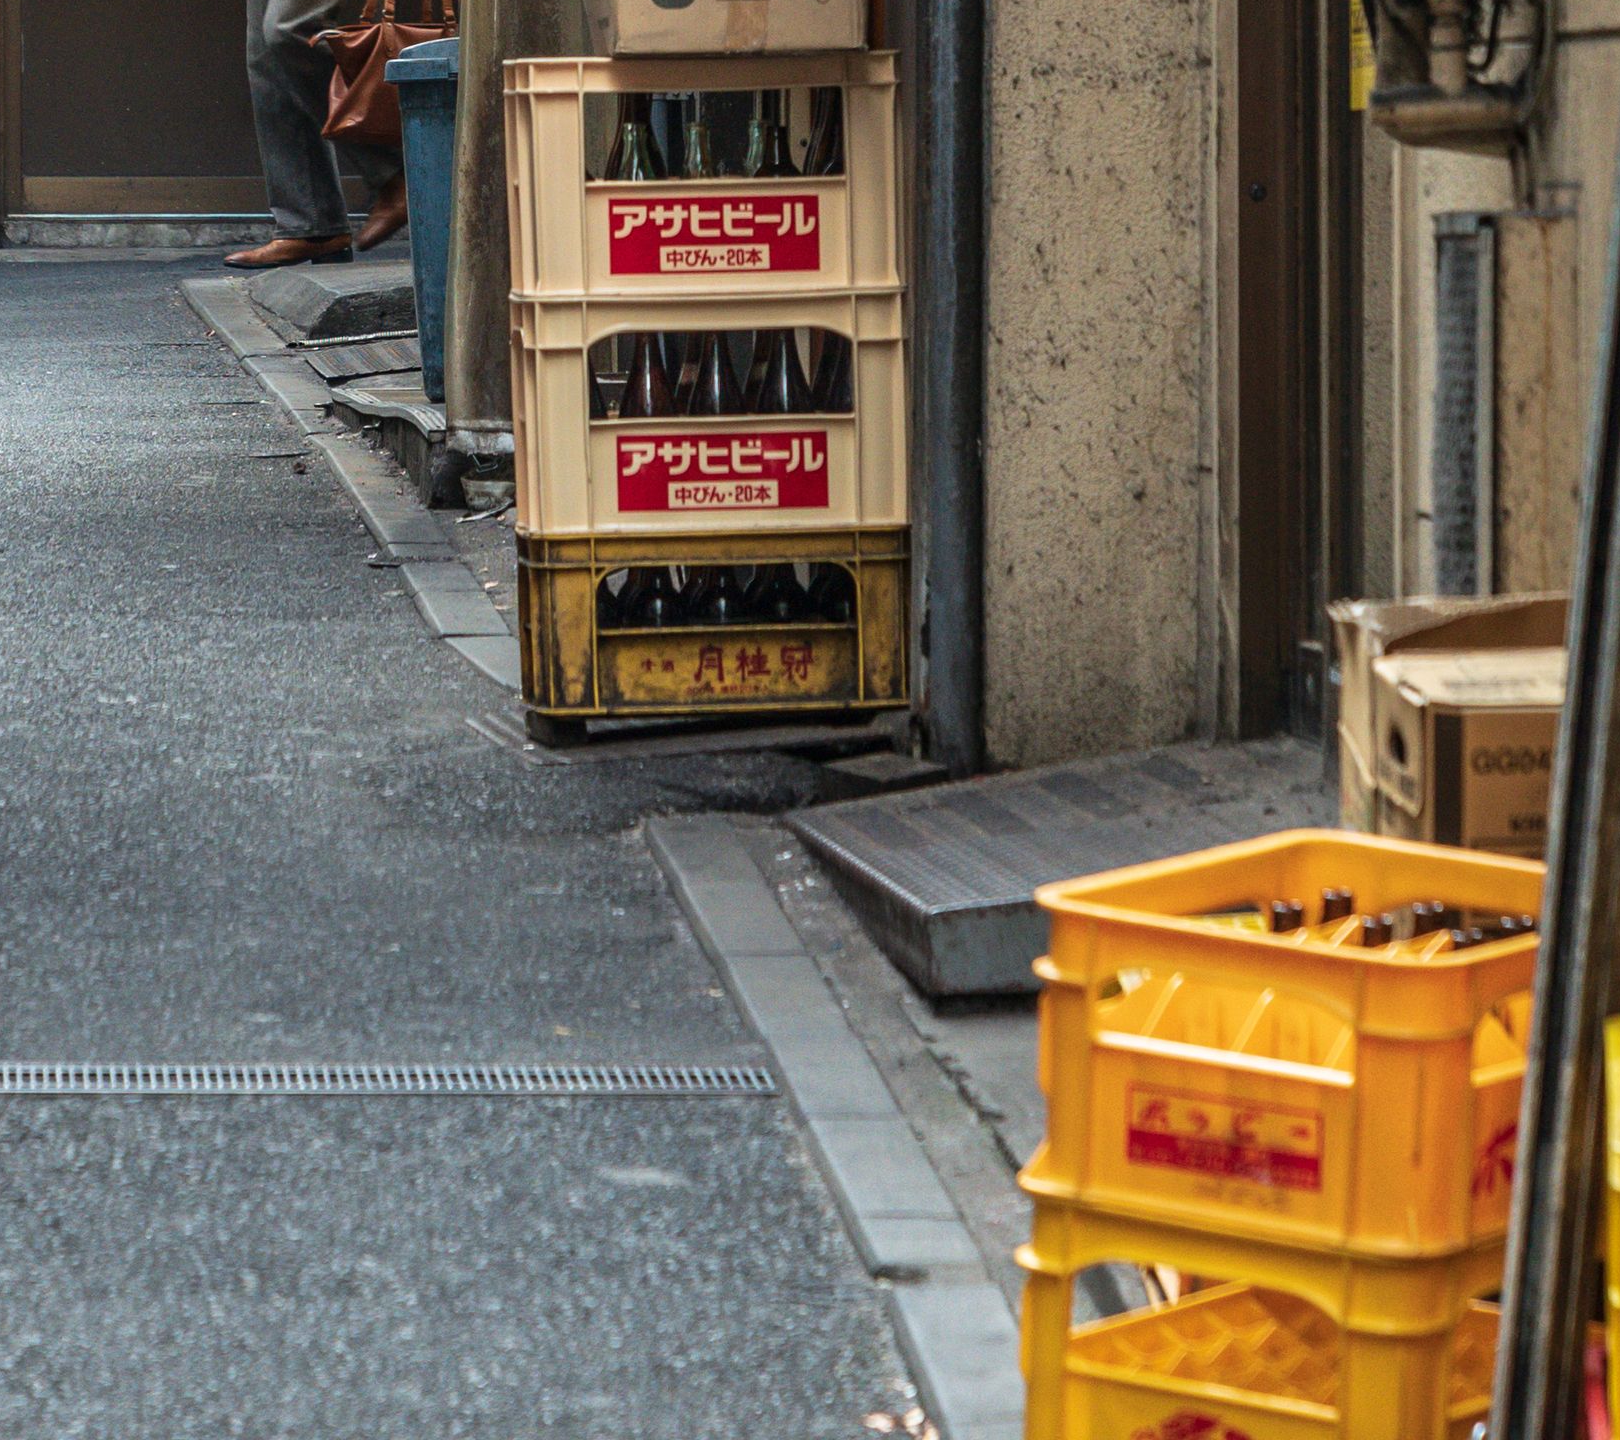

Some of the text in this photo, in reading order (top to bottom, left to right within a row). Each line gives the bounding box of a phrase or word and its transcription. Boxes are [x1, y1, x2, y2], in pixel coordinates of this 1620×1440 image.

[611, 201, 817, 241] アサヒビール
[665, 246, 764, 270] 中びん・20本
[620, 437, 825, 477] アサヒビール
[674, 482, 772, 506] 中びん・20本
[693, 644, 814, 684] 月桂冠
